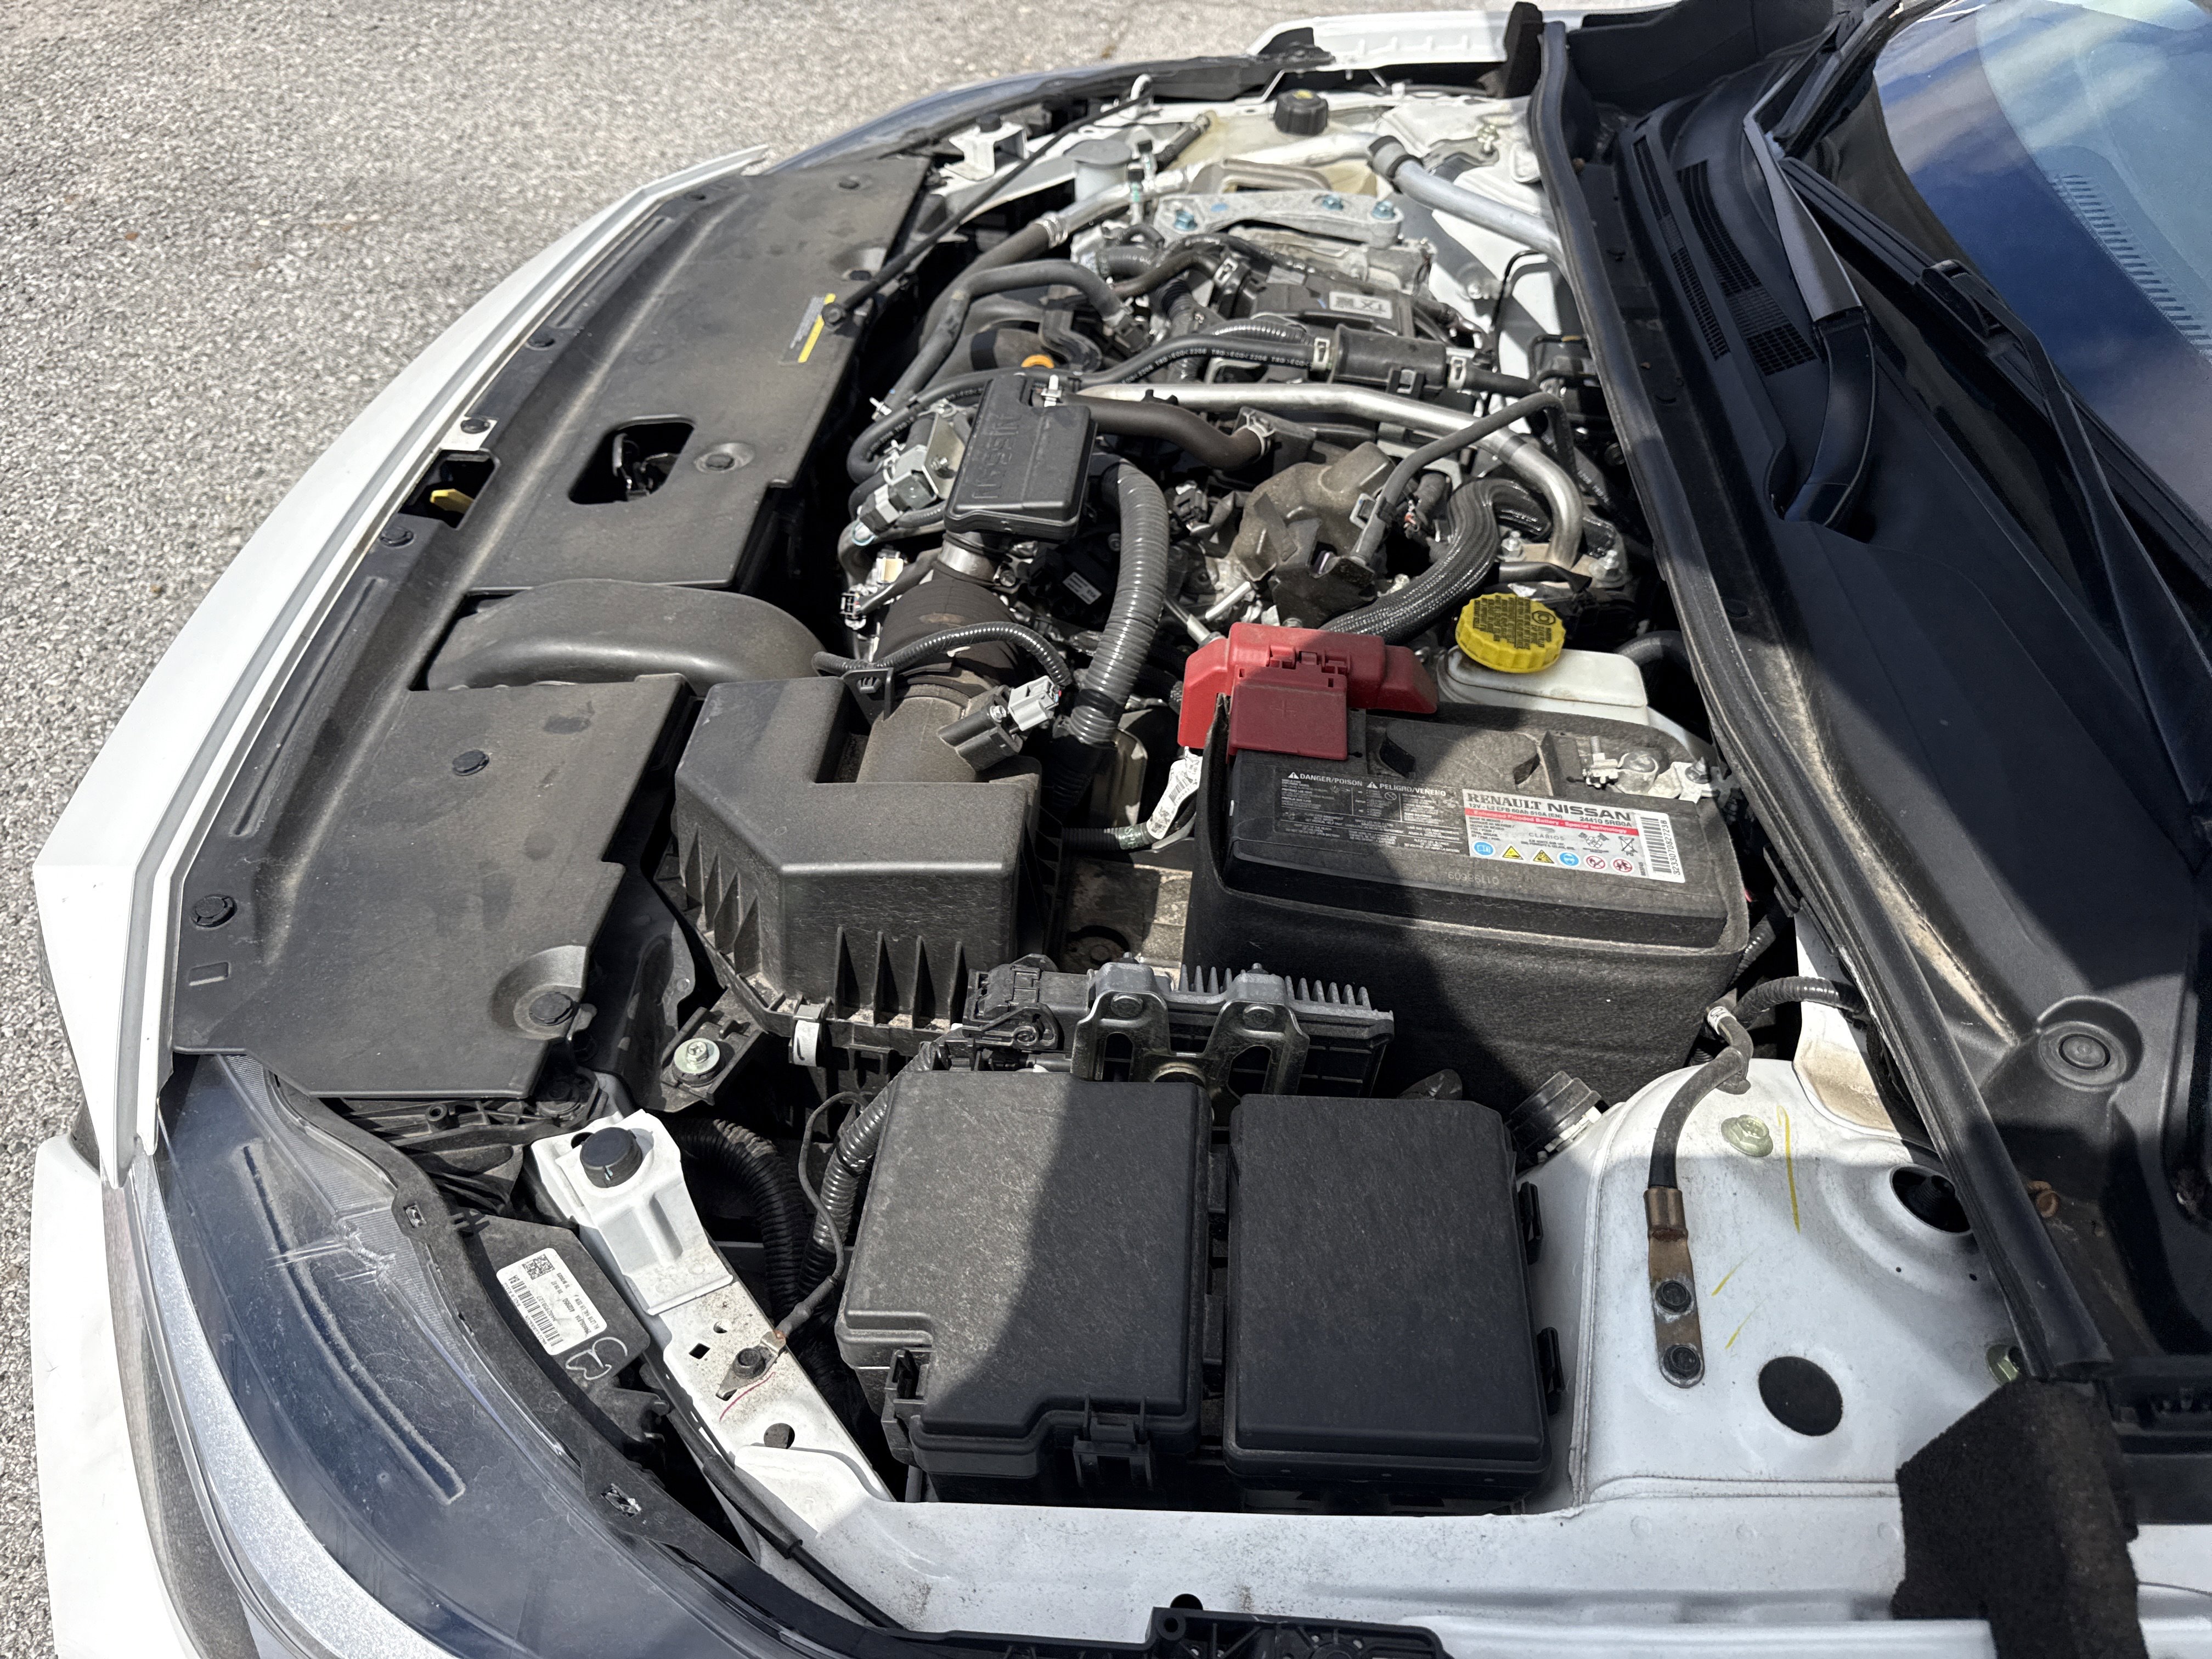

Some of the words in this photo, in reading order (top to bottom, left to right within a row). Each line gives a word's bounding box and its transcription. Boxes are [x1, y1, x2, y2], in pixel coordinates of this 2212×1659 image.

[1300, 774, 1363, 786] DANGER/POISON
[1379, 783, 1446, 796] PELIGRO/VENENO
[1467, 793, 1542, 810] RENAULT
[1548, 803, 1631, 821] NISSAN
[1474, 810, 1506, 819] Enhanced
[1508, 813, 1534, 822] Flooded
[1536, 817, 1559, 826] Battery
[1565, 821, 1589, 830] Special
[1590, 825, 1627, 834] technology
[1528, 832, 1565, 840] CLARIOS
